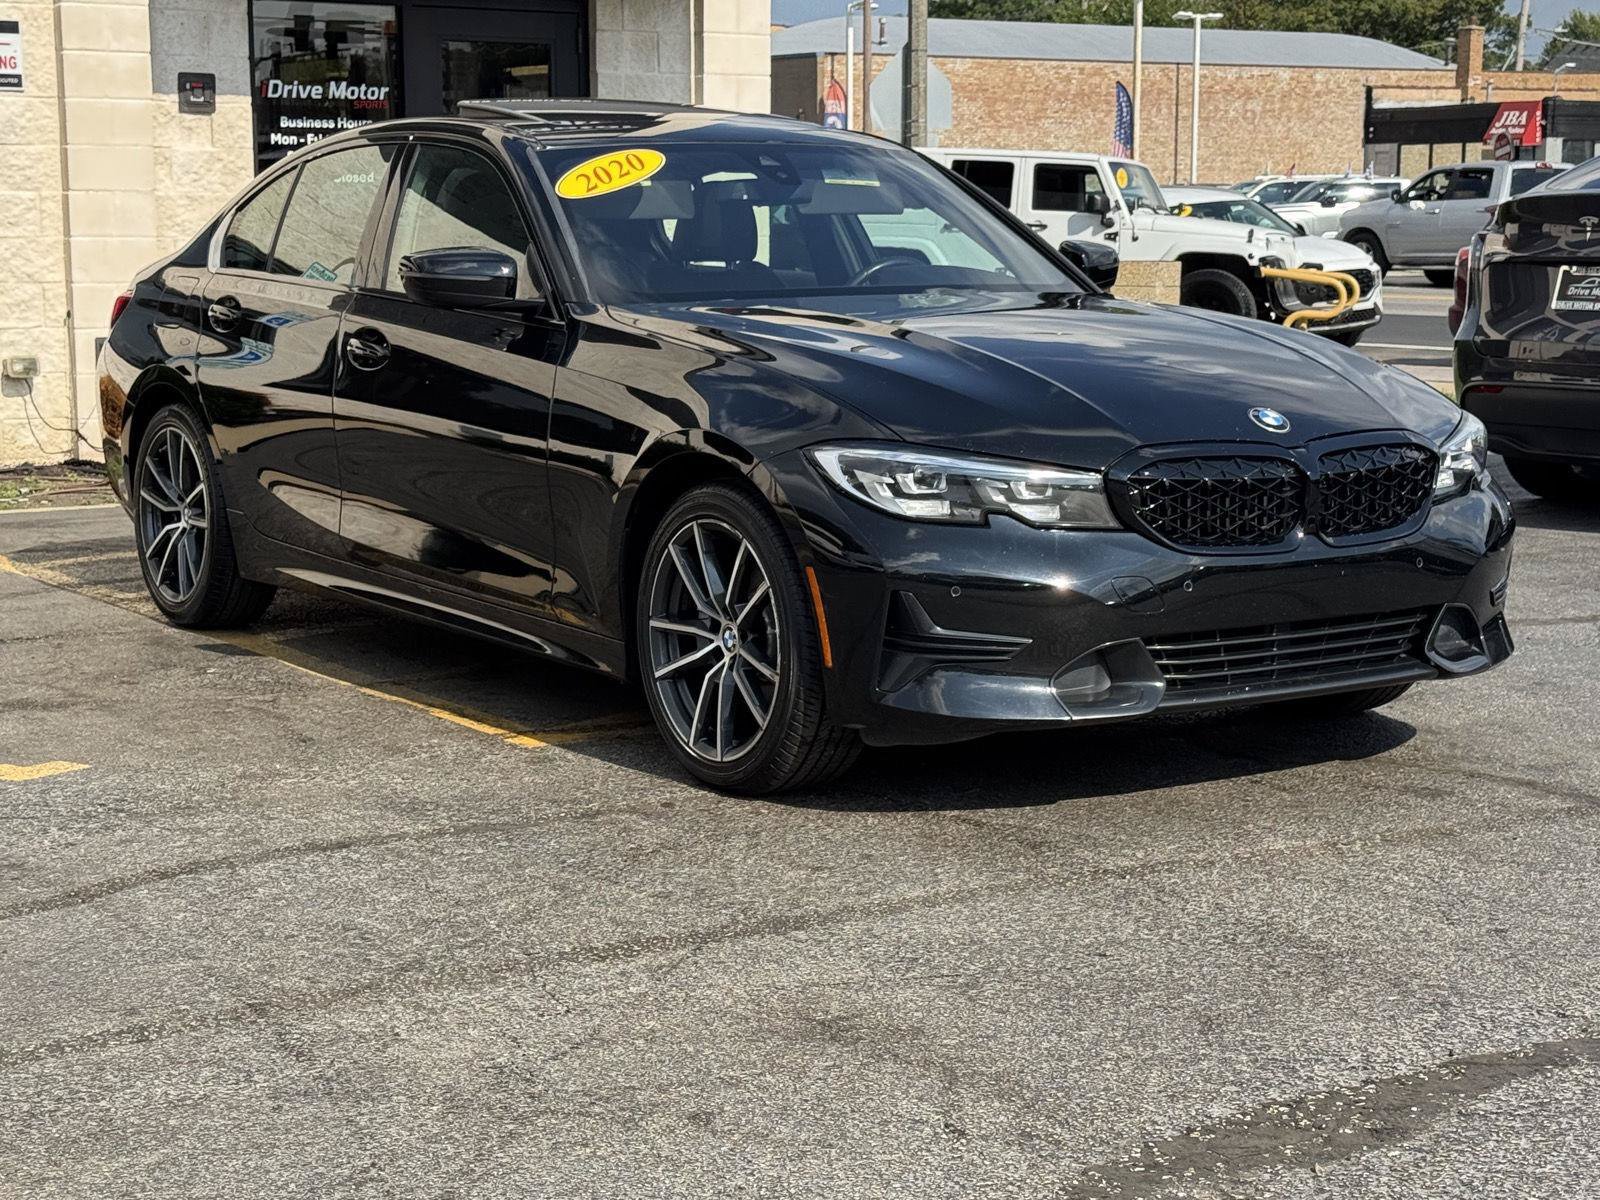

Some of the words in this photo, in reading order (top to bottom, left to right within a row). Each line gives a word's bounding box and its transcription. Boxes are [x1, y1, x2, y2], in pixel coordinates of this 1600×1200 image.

[261, 79, 323, 99] iDrive
[328, 80, 390, 100] Motor
[353, 100, 390, 109] SPORTS
[280, 115, 335, 129] Business
[1495, 110, 1528, 128] JBA
[270, 133, 297, 145] Mon
[575, 153, 645, 193] 2020
